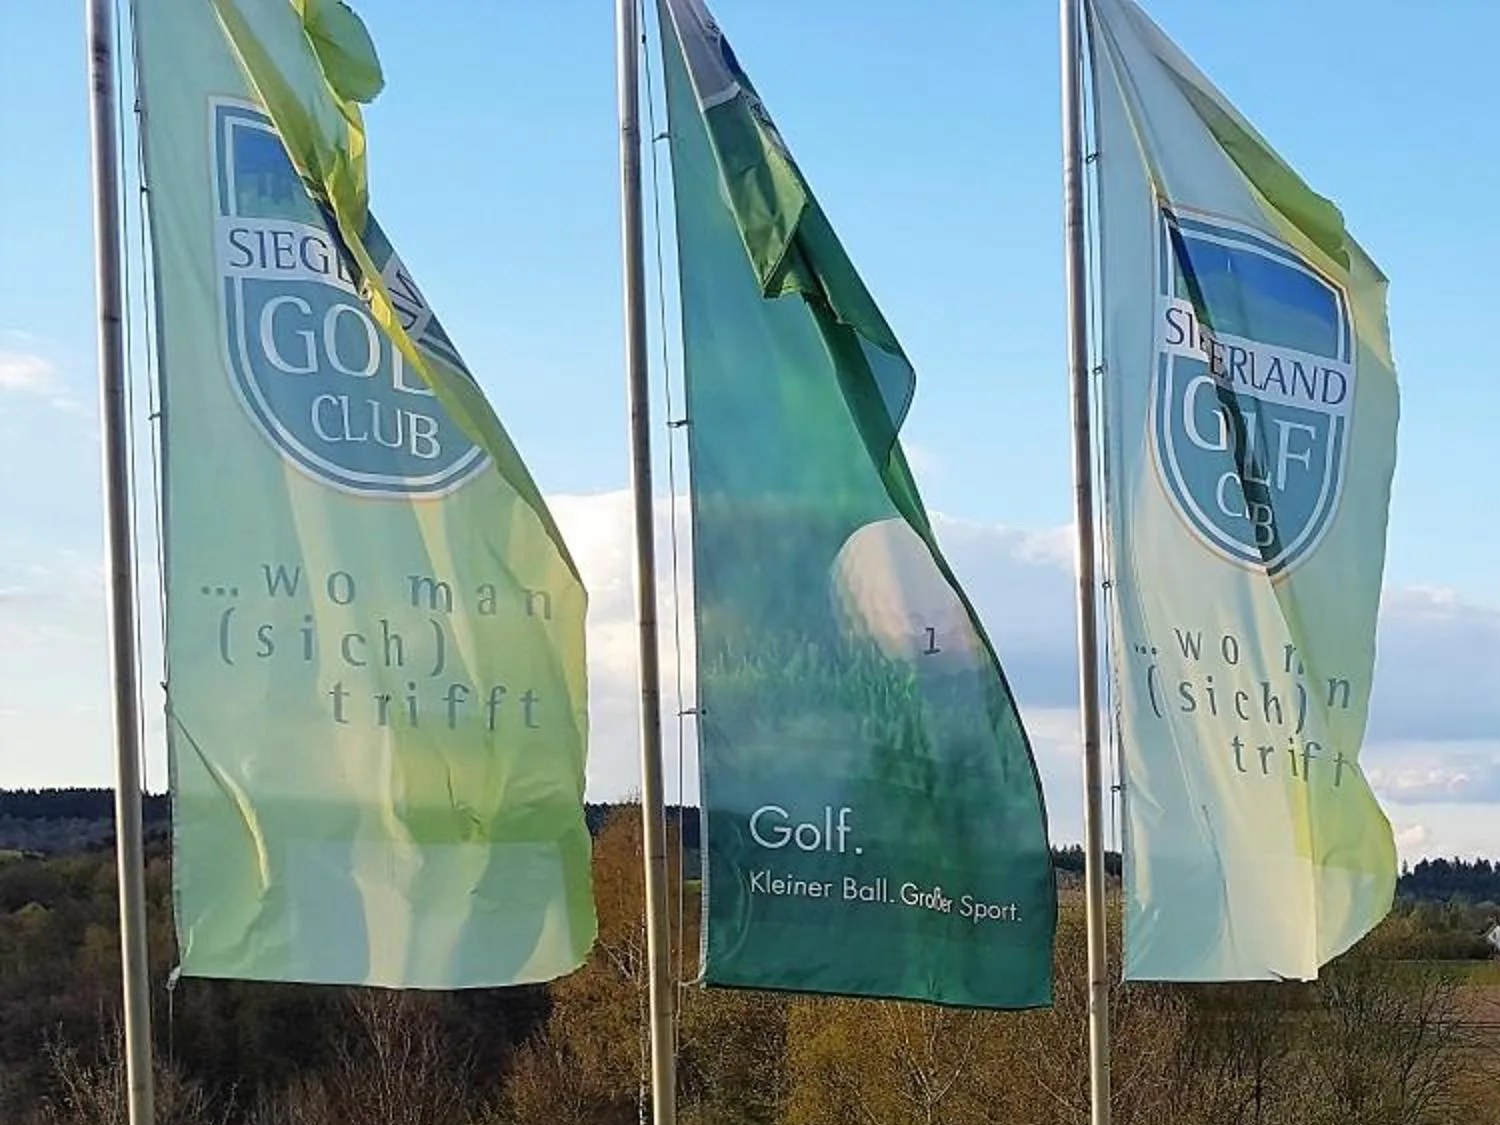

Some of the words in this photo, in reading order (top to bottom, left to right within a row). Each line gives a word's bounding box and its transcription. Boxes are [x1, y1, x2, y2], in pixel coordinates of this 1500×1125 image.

[260, 295, 435, 397] GOL
[311, 394, 442, 460] CLUB
[1183, 375, 1317, 491] GLF
[408, 574, 553, 620] man
[218, 607, 446, 677] (sich)
[923, 627, 941, 656] 1
[329, 680, 542, 730] trifft
[1146, 664, 1308, 735] (sich)
[749, 805, 863, 856] Golf.
[750, 871, 832, 898] Kleiner
[843, 876, 895, 904] Ball.
[900, 882, 953, 913] Großer
[959, 895, 1022, 924] Sport.
